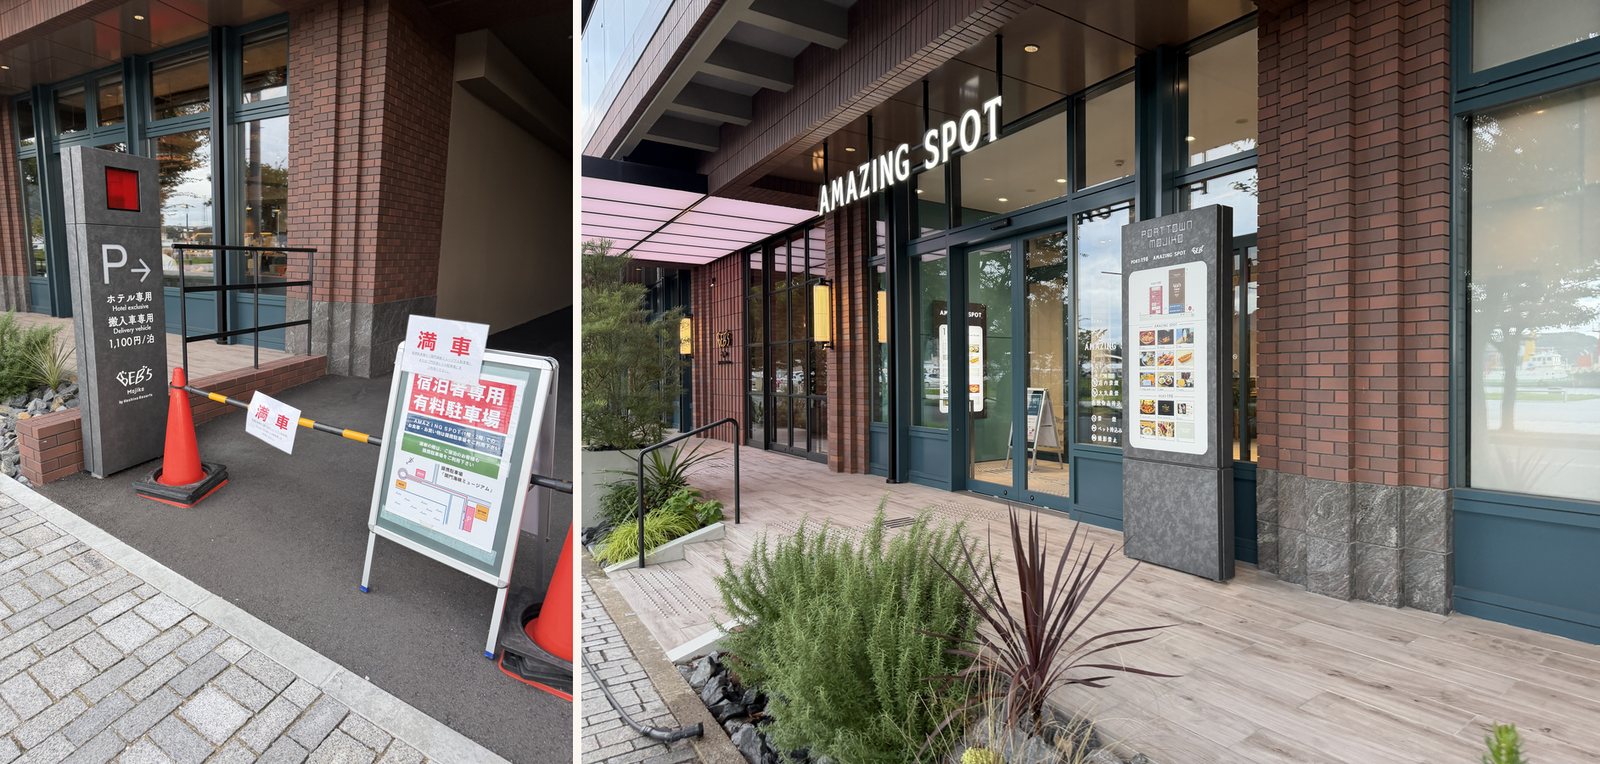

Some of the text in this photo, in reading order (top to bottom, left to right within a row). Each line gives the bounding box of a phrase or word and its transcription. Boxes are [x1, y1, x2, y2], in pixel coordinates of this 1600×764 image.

[819, 96, 1002, 216] AMAZING SPOT
[1141, 220, 1193, 239] PORTTOWN
[101, 244, 128, 285] P
[1153, 252, 1173, 260] AMAZING
[107, 292, 153, 304] ホテル専用
[108, 313, 154, 327] 搬入車専用
[109, 334, 155, 349] 1,100円/泊
[417, 331, 472, 356] 満車
[1084, 342, 1117, 350] AMAZING
[255, 404, 290, 430] 満車
[413, 394, 501, 429] 有料駐車場
